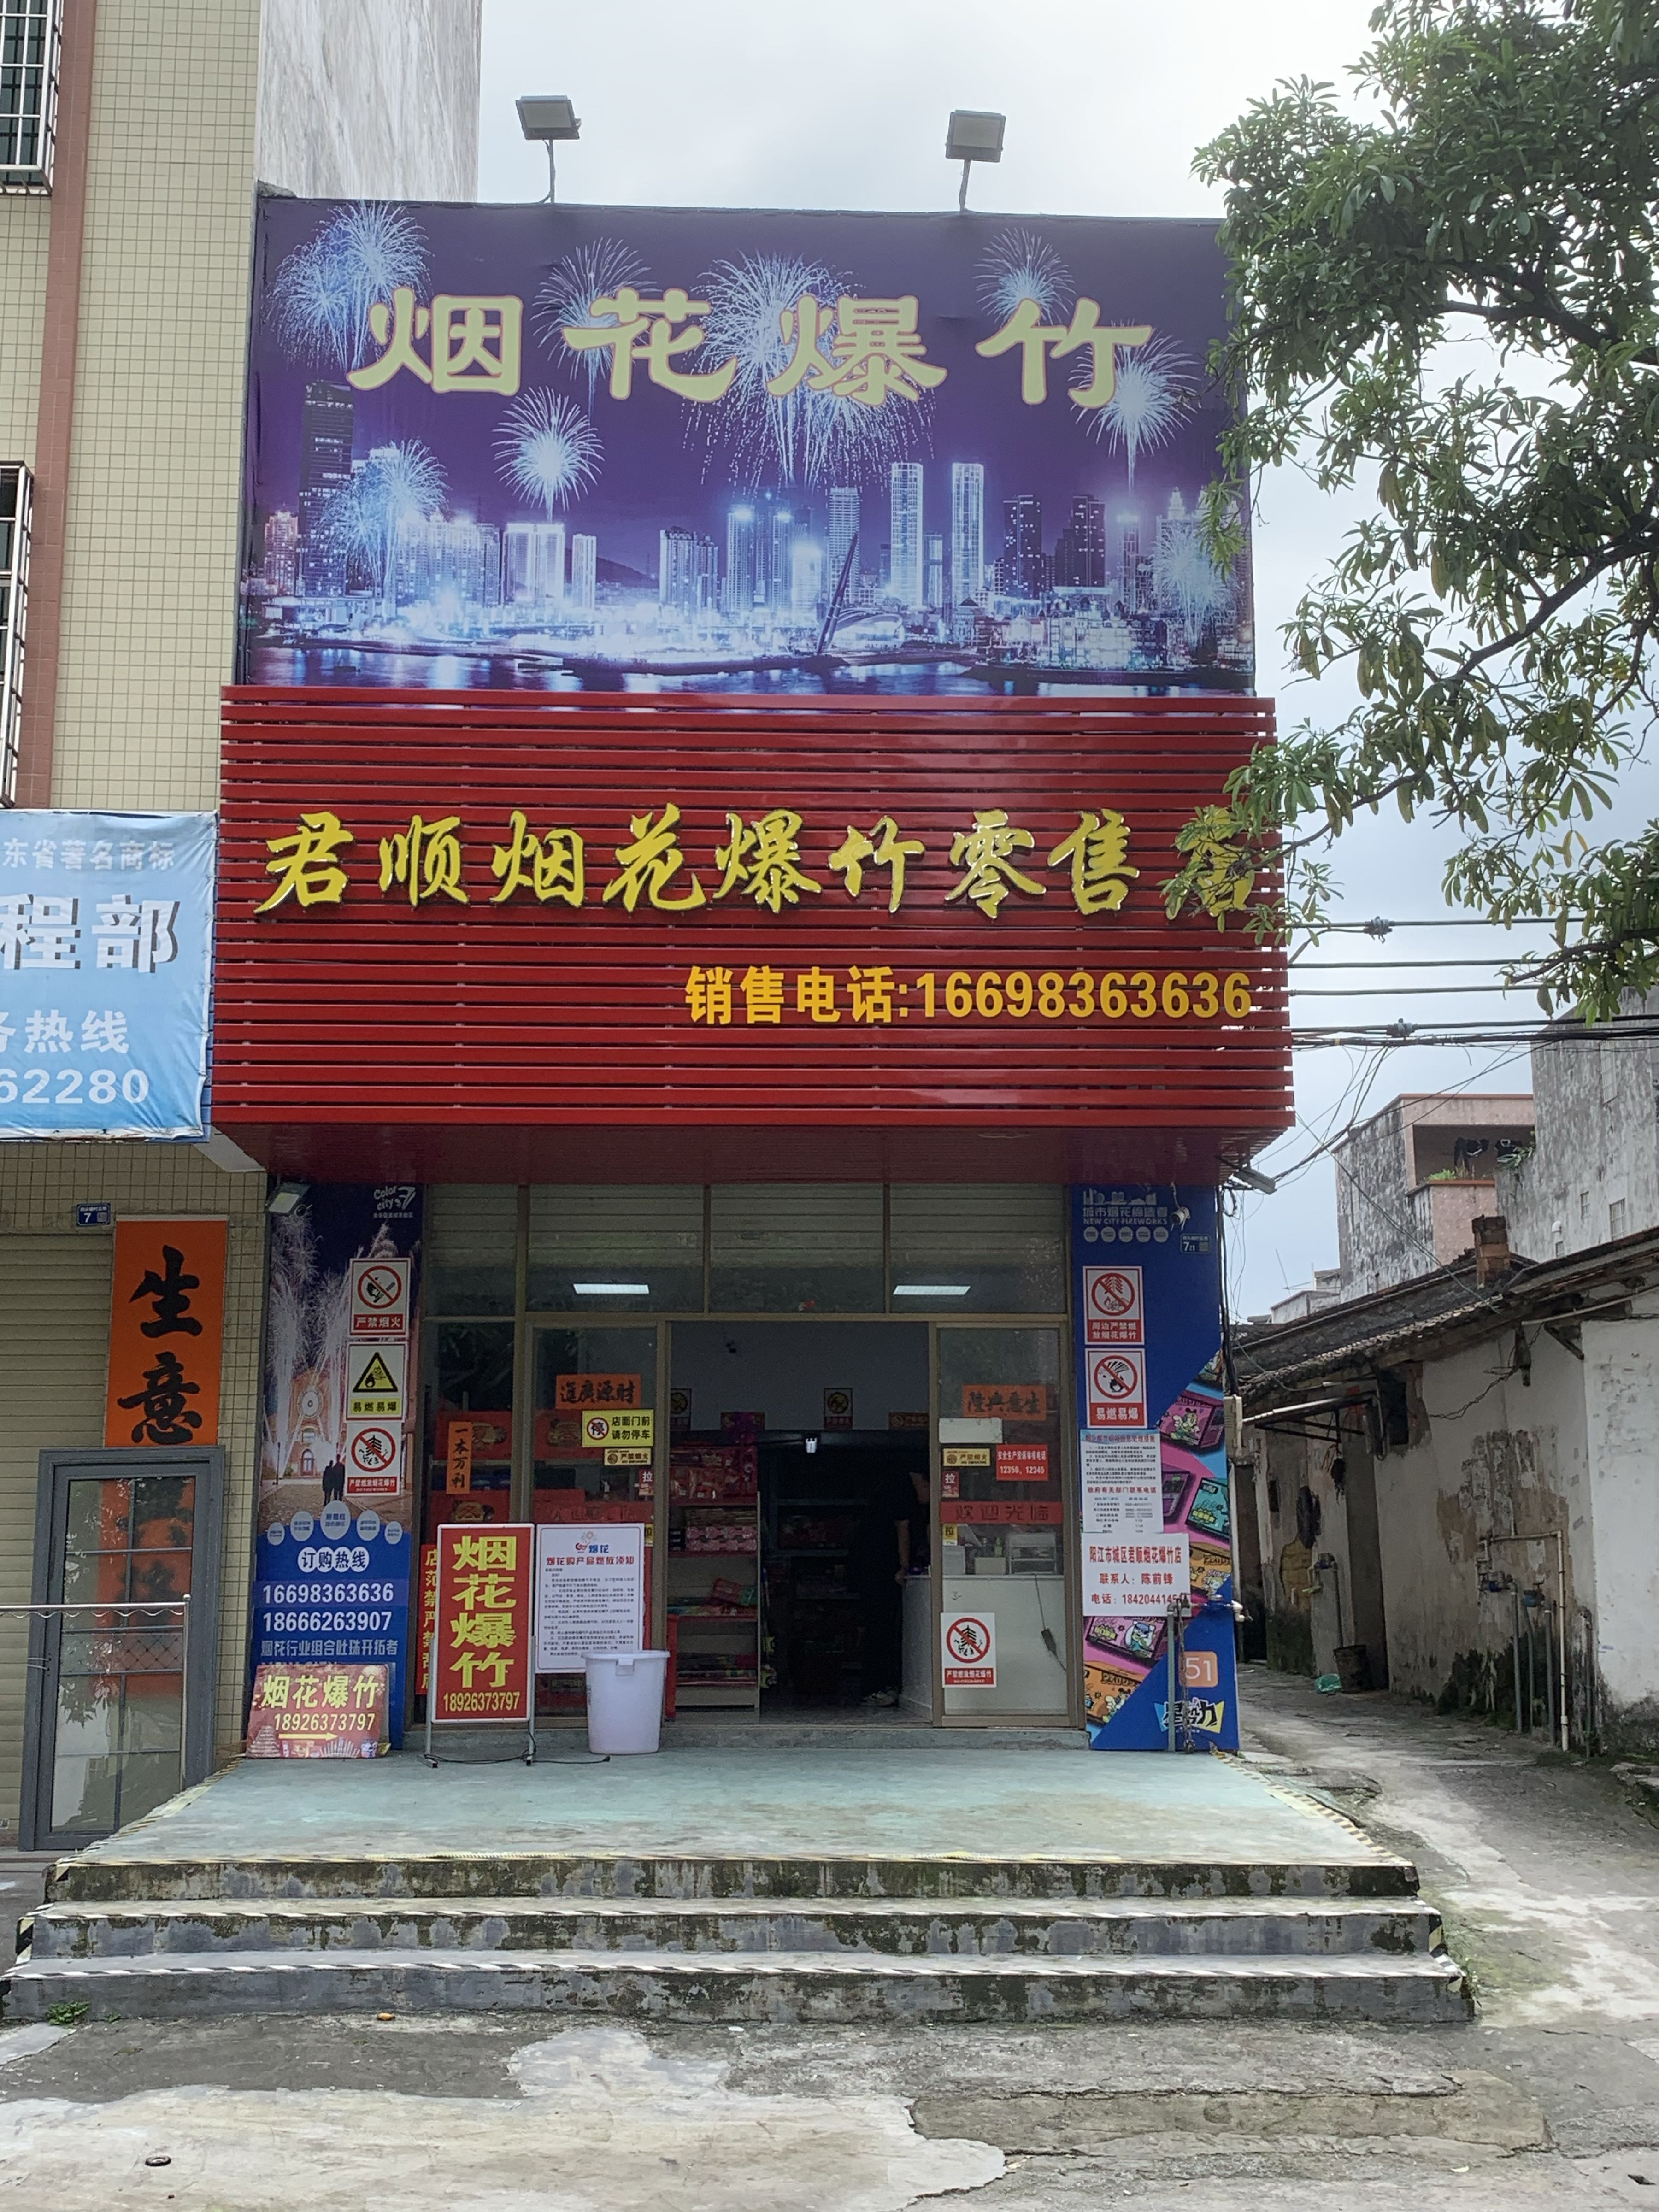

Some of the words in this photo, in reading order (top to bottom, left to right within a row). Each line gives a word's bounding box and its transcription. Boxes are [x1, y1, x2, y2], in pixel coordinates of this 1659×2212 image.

[347, 287, 1153, 408] 烟花爆竹
[2, 838, 174, 871] 东省著名商标
[685, 965, 1252, 1025] 销售电话:16698363636
[0, 1068, 149, 1104] 62280
[84, 1212, 91, 1223] 7
[355, 1316, 400, 1329] 严禁烟火
[1092, 1322, 1136, 1330] 周边严禁燃
[1092, 1331, 1136, 1339] 放烟花爆竹
[118, 1245, 203, 1445] 生意
[353, 1401, 397, 1412] 易燃易爆
[1096, 1408, 1138, 1420] 易燃易爆
[612, 1416, 650, 1426] 店面门前
[612, 1430, 651, 1441] 请勿停车
[451, 1428, 469, 1488] 一本万利
[642, 1471, 653, 1483] 拉
[945, 1473, 956, 1484] 拉
[955, 1505, 1049, 1521] 欢迎光临
[945, 1526, 954, 1536] 拉
[302, 1551, 366, 1568] 订购热线
[1089, 1546, 1182, 1564] 阳江市城区君顺烟花爆竹店
[263, 1583, 394, 1604] 16698363636
[450, 1535, 517, 1688] 烟花爆竹
[263, 1611, 393, 1632] 18666263907
[1185, 1658, 1212, 1681] 51
[261, 1674, 379, 1709] 烟花爆竹
[443, 1692, 520, 1712] 18926373797
[274, 1713, 376, 1731] 18926373797
